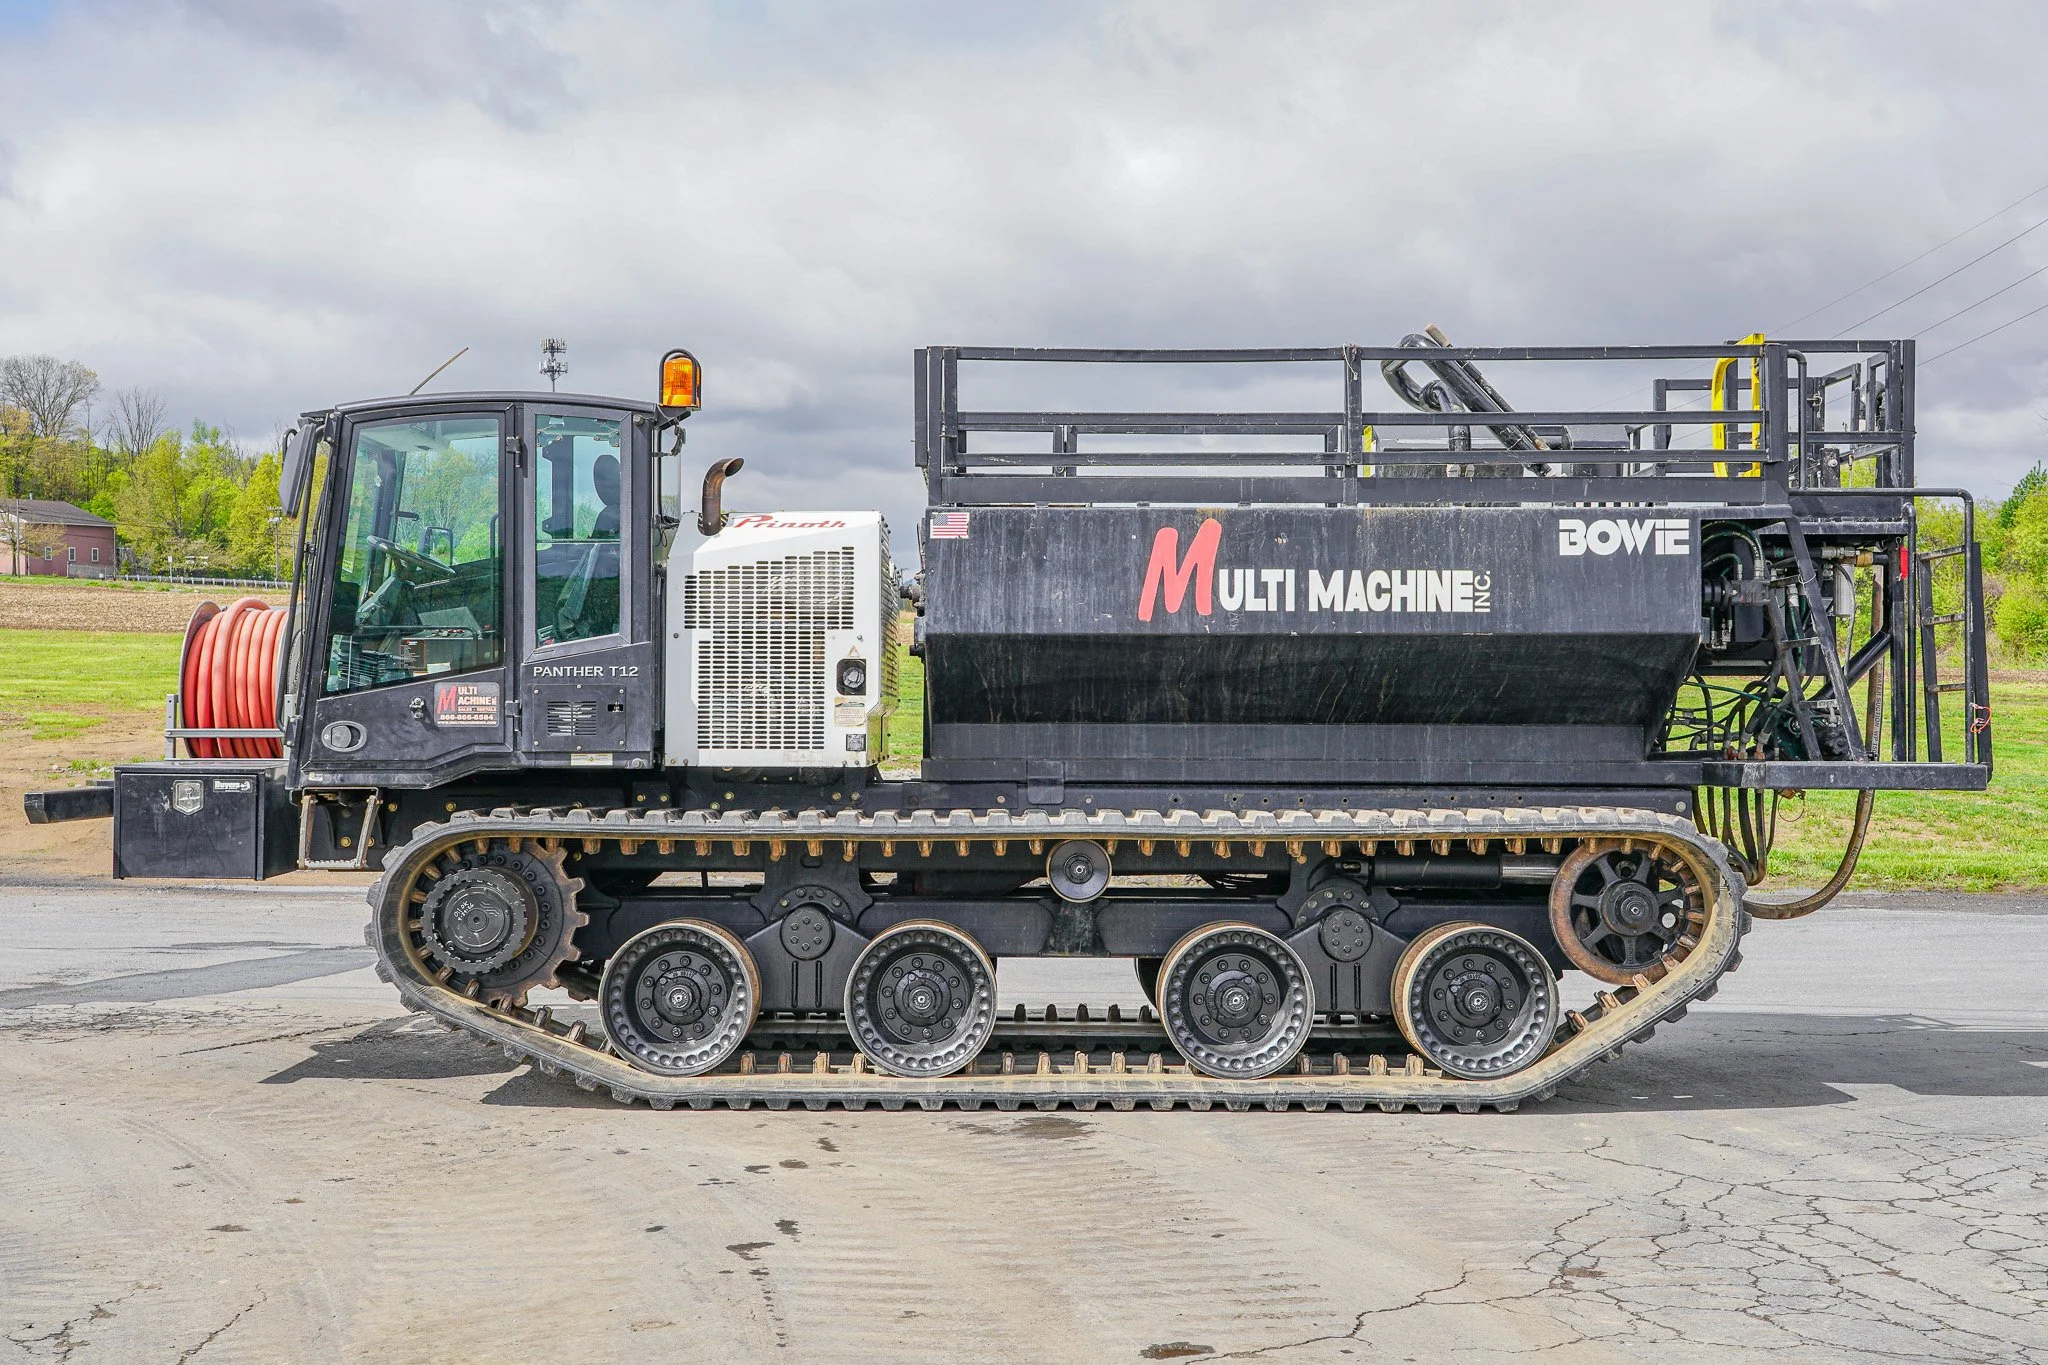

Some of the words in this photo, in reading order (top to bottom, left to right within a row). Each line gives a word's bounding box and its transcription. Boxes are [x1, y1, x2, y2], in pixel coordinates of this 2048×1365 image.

[733, 514, 846, 529] Prinoth
[1558, 518, 1690, 556] BOWIE
[1308, 569, 1474, 612] MACHINE
[1474, 571, 1491, 612] INC.
[533, 666, 603, 677] PANTHER
[609, 666, 639, 677] T12
